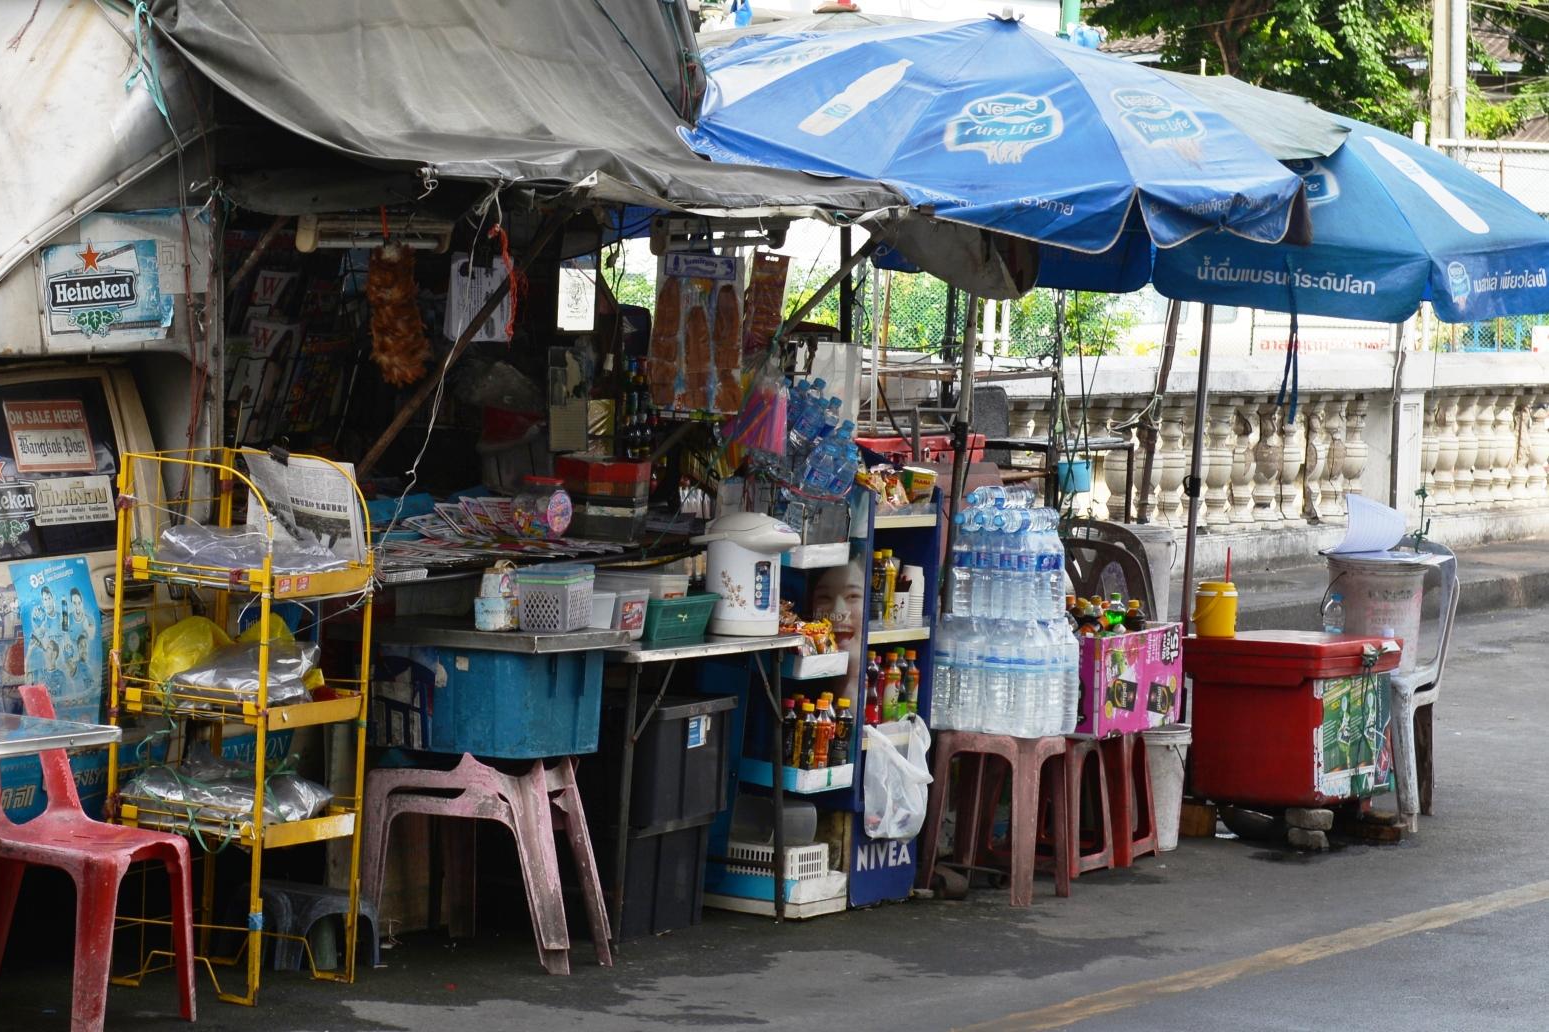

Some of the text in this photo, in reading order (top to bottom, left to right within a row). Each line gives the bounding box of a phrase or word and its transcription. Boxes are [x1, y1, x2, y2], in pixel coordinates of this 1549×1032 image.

[54, 281, 131, 303] Heineken
[8, 409, 84, 425] ON SALE HERE!
[18, 434, 87, 457] Bangkok Post
[856, 841, 912, 872] NIVEA
